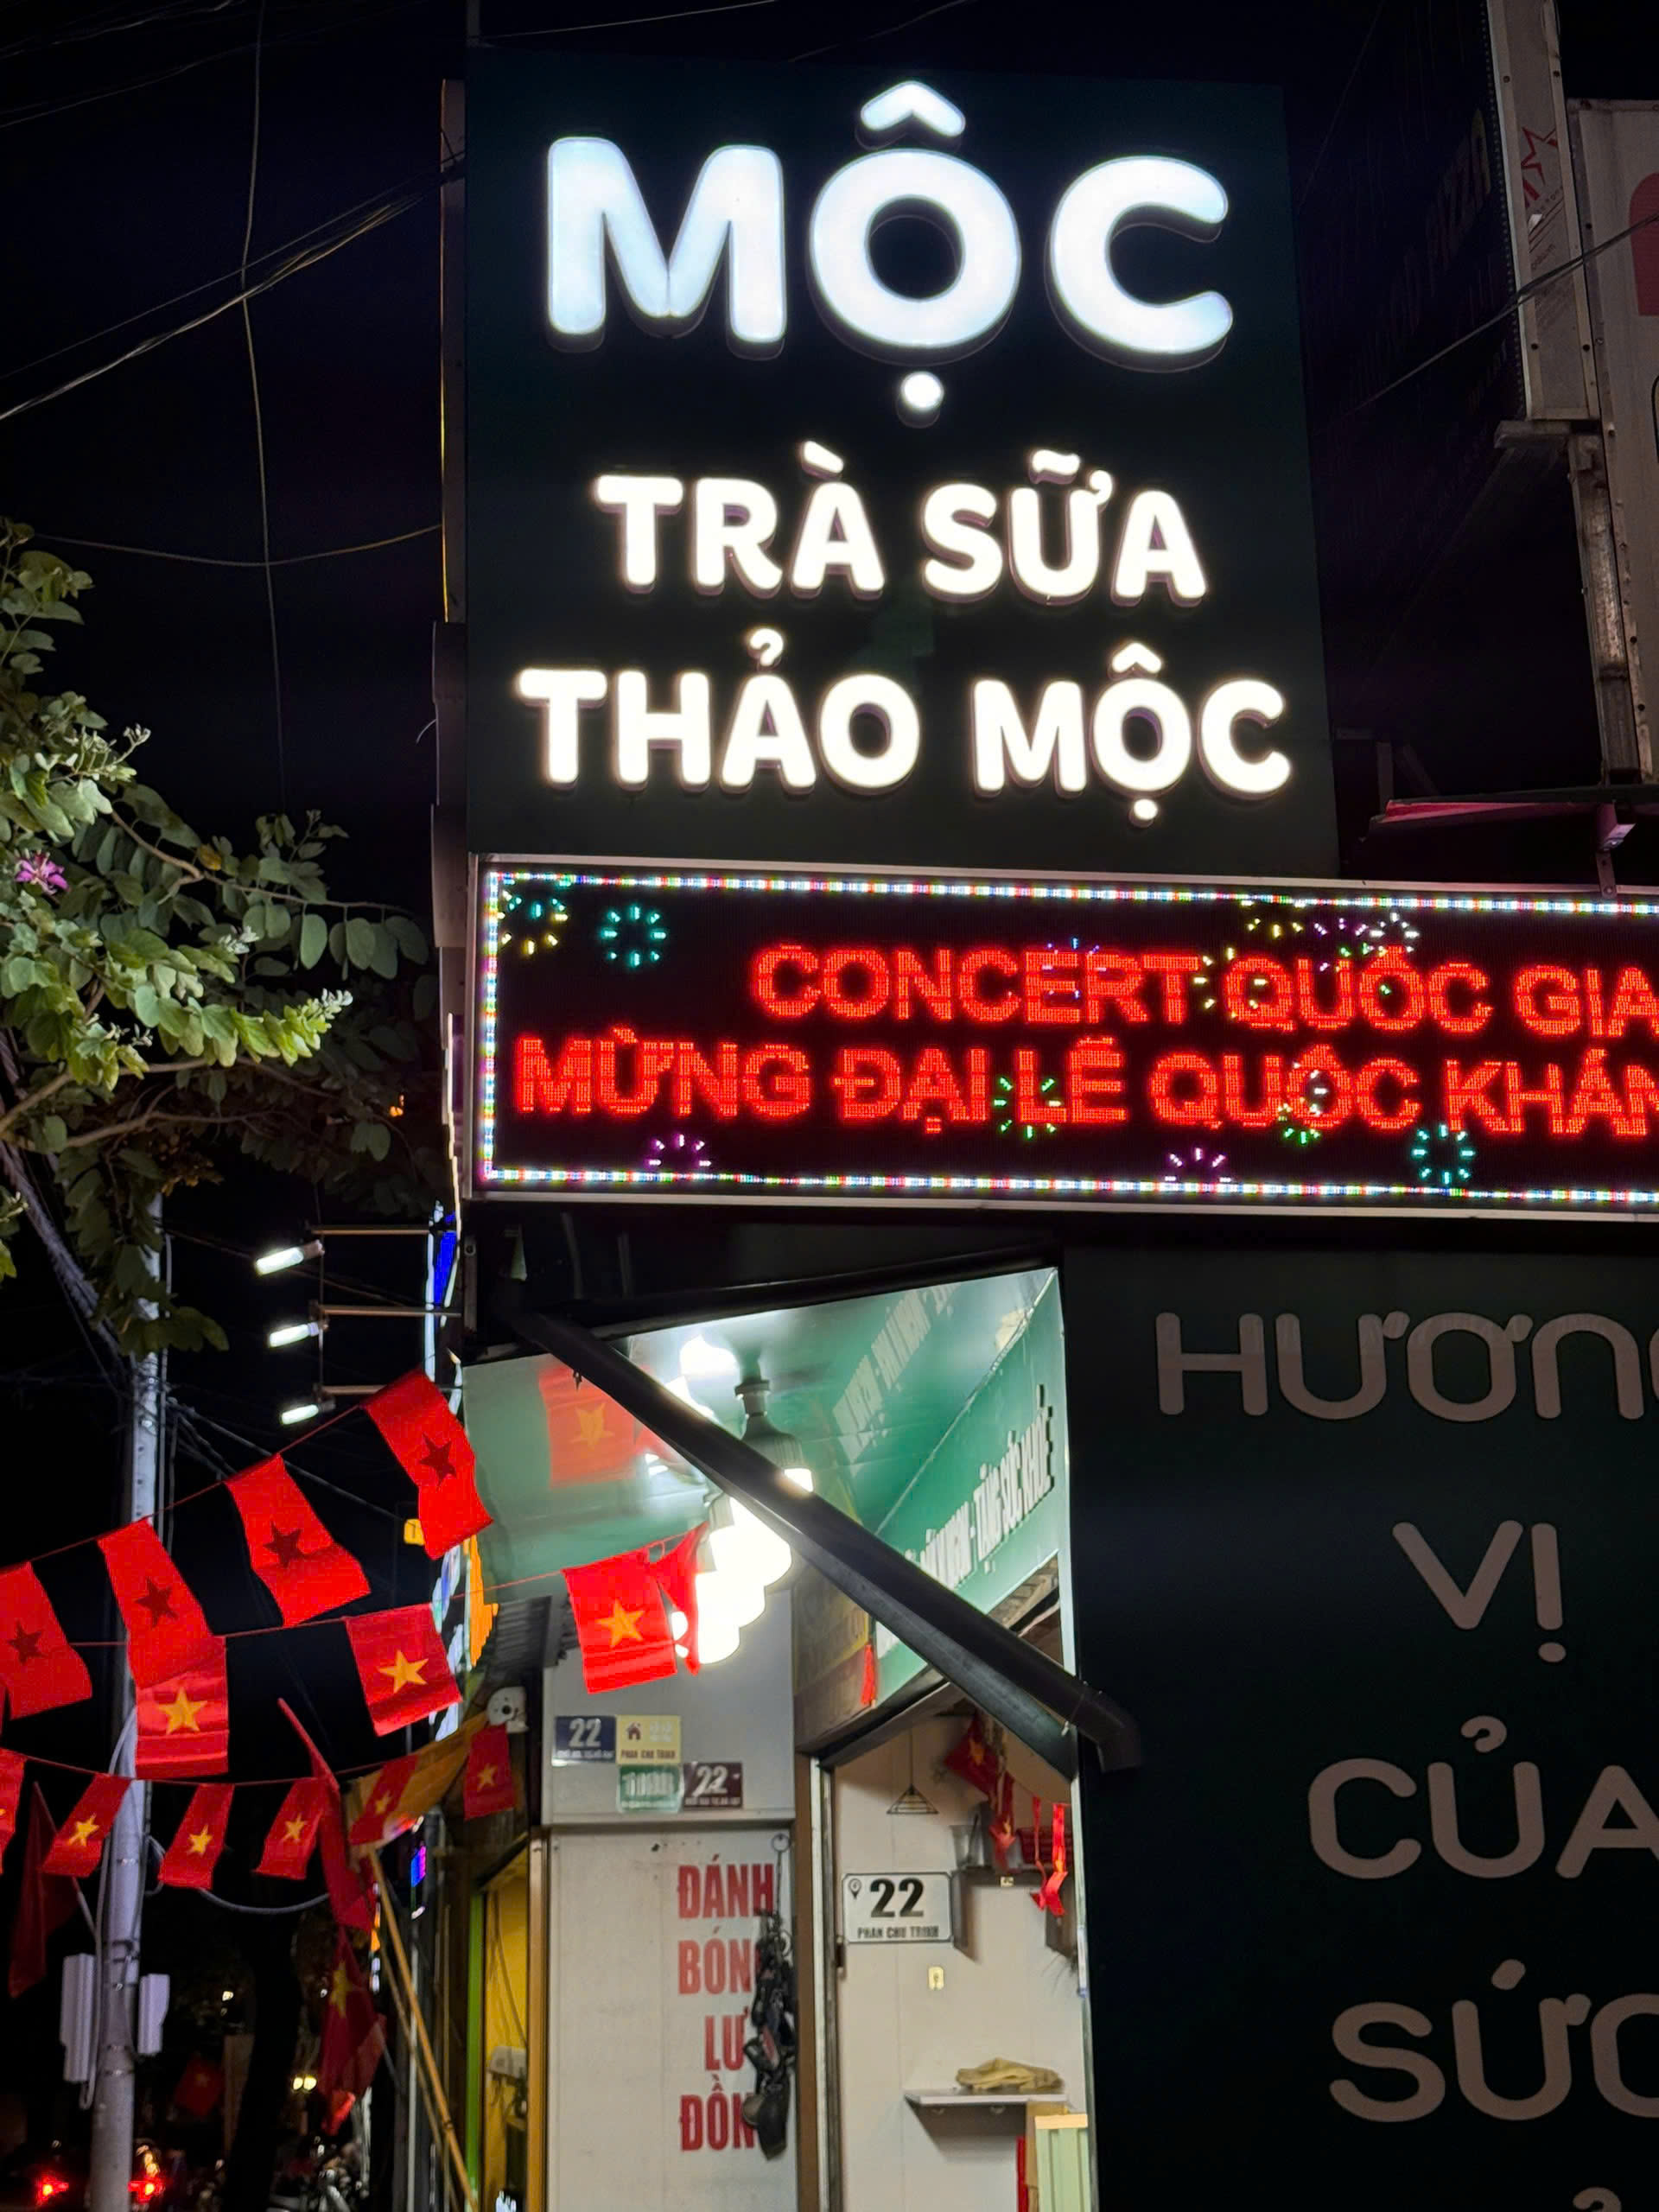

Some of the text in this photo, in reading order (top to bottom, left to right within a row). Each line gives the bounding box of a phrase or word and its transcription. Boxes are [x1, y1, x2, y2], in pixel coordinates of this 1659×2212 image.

[546, 80, 1234, 416] MỘC
[594, 440, 1209, 602] TRÀ SỮA
[518, 628, 1292, 821] THẢO MỘC
[753, 944, 1199, 1024] CONCERT
[1514, 963, 1659, 1038] GIA
[517, 1026, 810, 1118] MỪNG
[831, 1047, 986, 1135] ĐẠI
[1017, 1036, 1127, 1123] LỄ
[1148, 1042, 1421, 1130] QUỐC
[1392, 1520, 1567, 1662] VỊ
[569, 1718, 601, 1747] 22
[692, 1765, 728, 1796] 22
[1308, 1715, 1659, 1879] CỦA
[677, 1853, 774, 1918] ĐÁNH
[870, 1878, 925, 1917] 22
[677, 1925, 761, 1994] BÓN
[678, 2073, 757, 2152] ĐỒN
